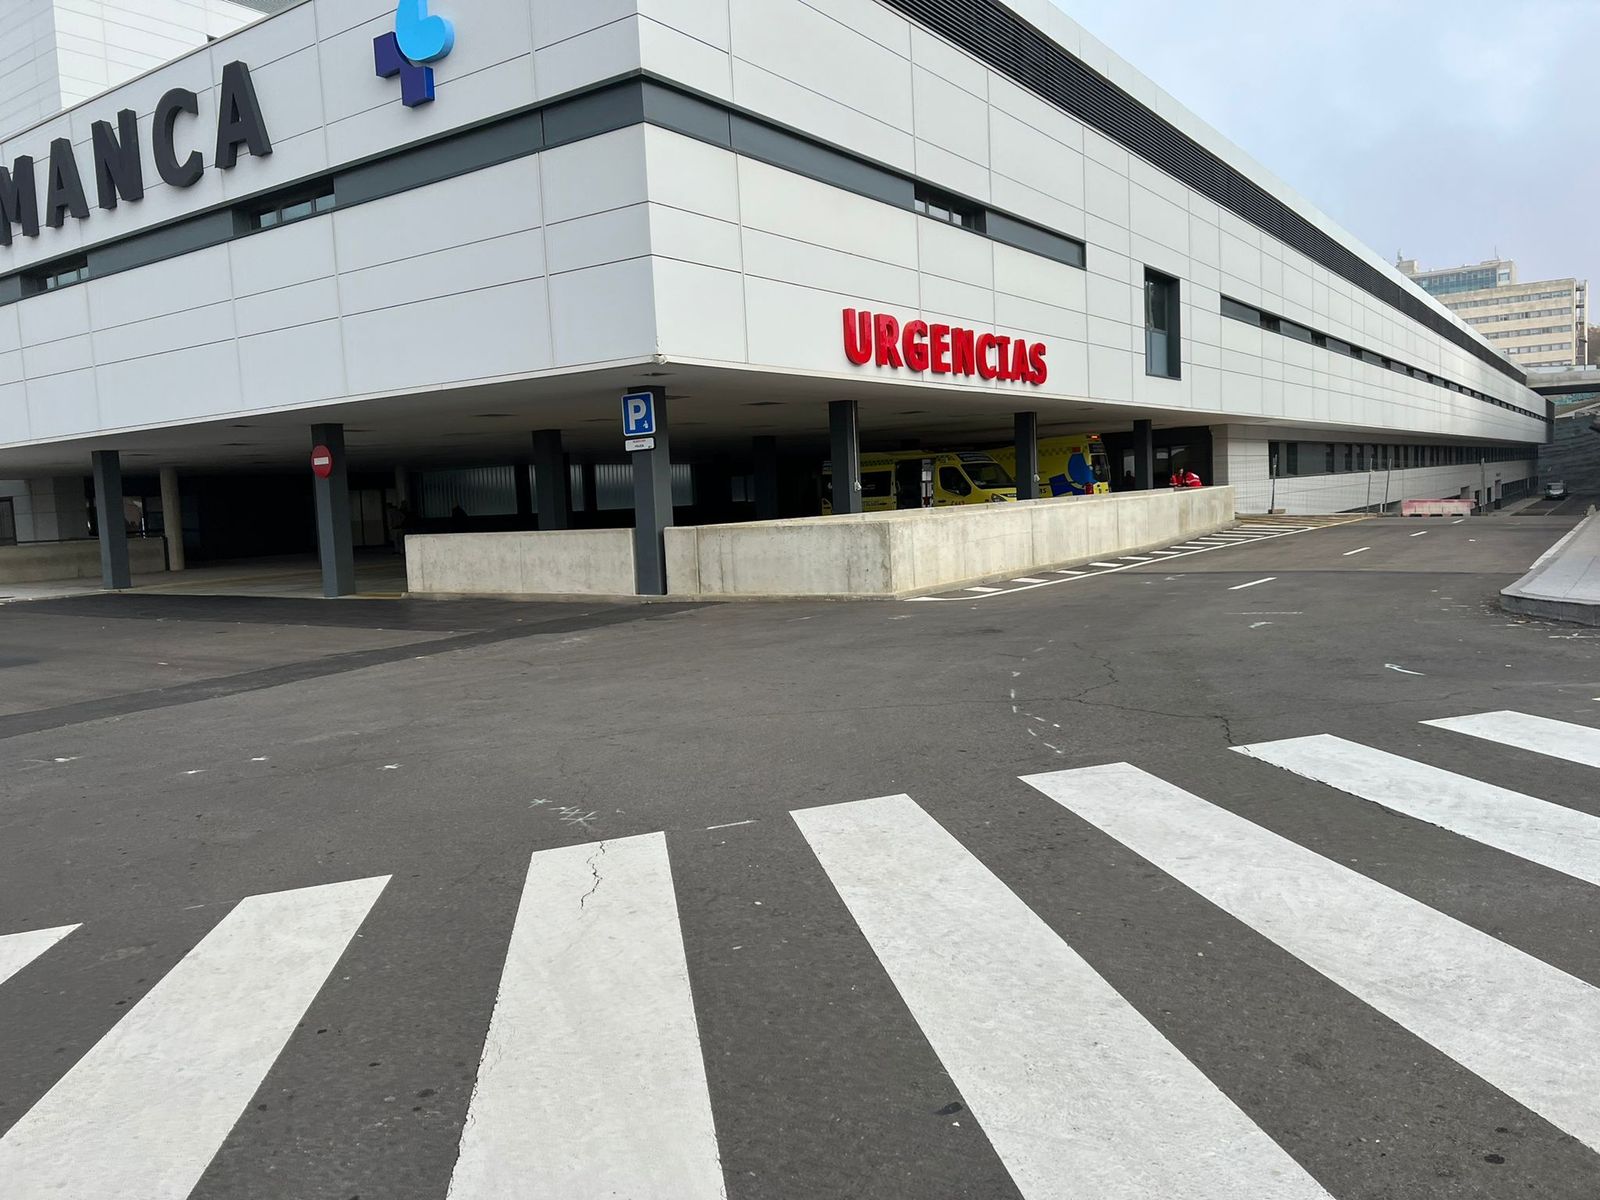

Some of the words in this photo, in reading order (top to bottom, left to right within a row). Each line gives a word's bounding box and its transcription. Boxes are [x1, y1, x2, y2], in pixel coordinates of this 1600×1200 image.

[0, 60, 273, 246] MANCA
[842, 308, 1048, 385] URGENCIAS
[628, 398, 647, 431] P
